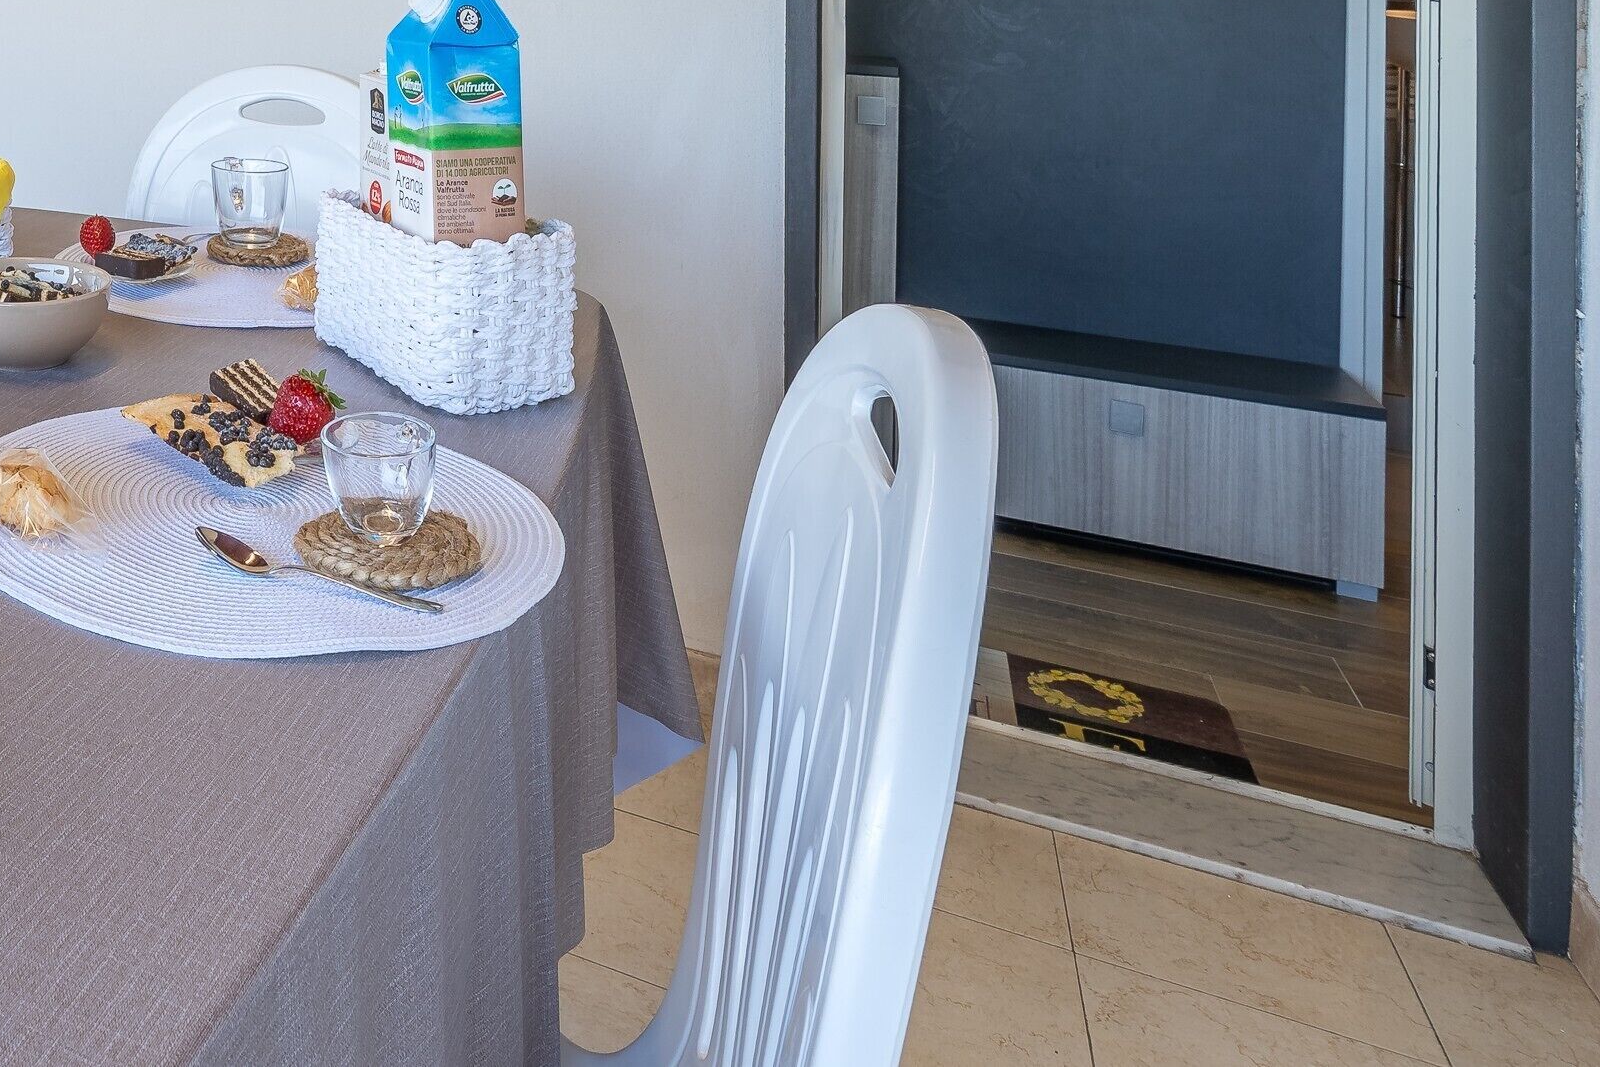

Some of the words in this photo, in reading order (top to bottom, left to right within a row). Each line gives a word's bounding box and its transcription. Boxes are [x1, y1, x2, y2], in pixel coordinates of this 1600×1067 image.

[453, 80, 495, 94] Valfrutta
[436, 159, 458, 168] SIAMO
[460, 158, 473, 167] UNA
[474, 156, 517, 167] COOPERATIVA
[436, 169, 443, 178] DI
[445, 168, 468, 178] 14.000
[469, 166, 509, 177] AGRICOLTORI
[396, 170, 424, 195] Arancia
[436, 186, 465, 194] Valfrutta
[398, 190, 421, 214] Rossa
